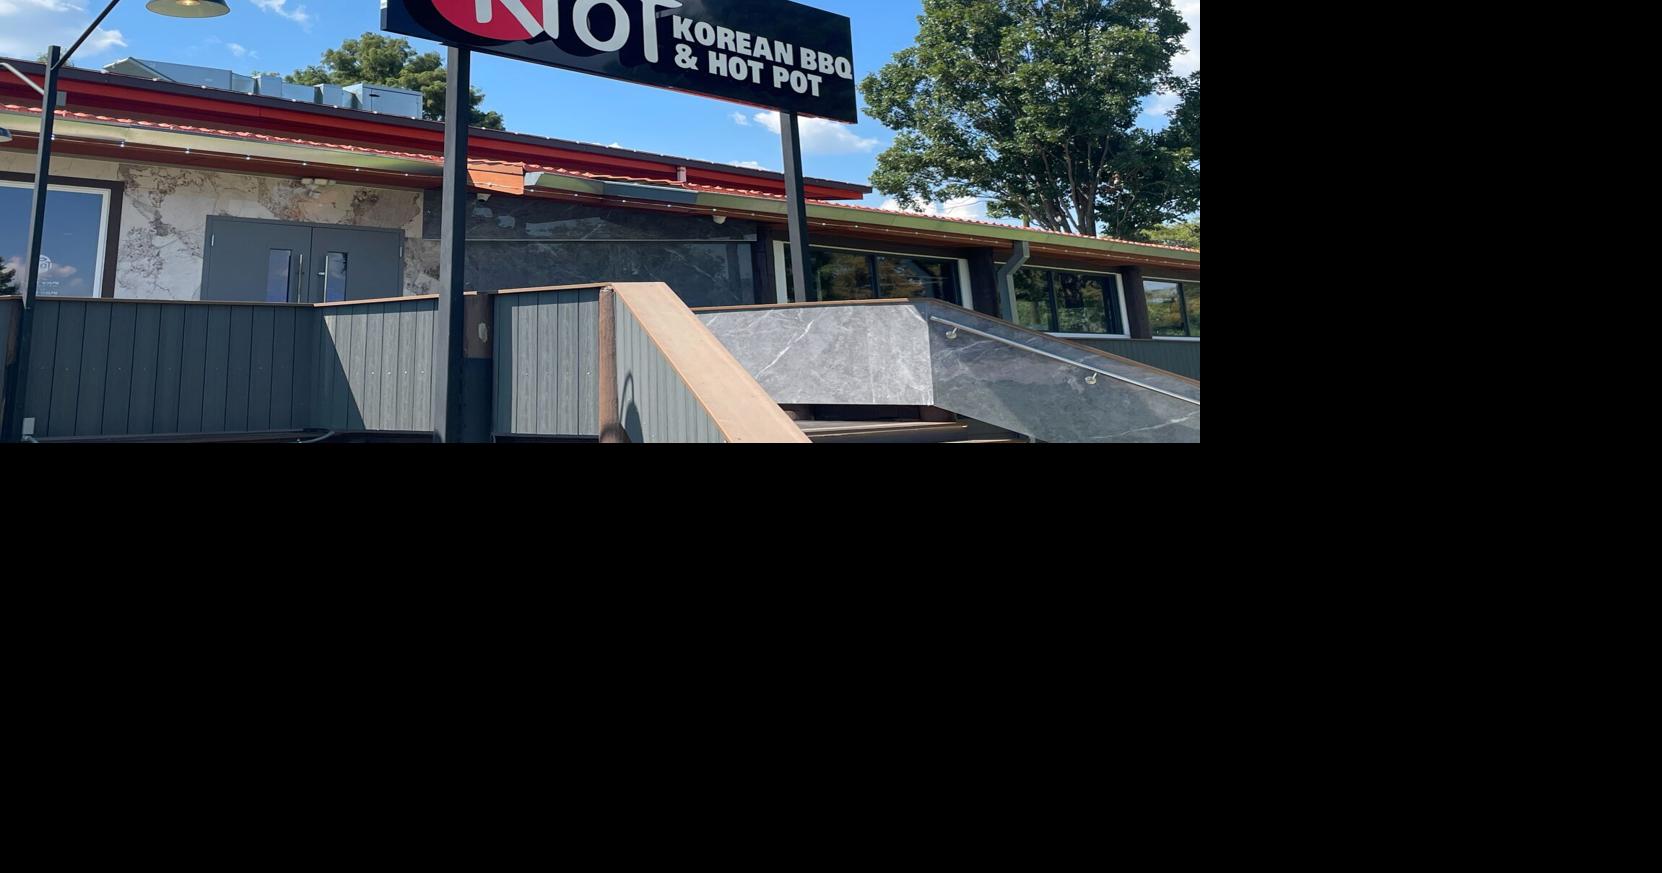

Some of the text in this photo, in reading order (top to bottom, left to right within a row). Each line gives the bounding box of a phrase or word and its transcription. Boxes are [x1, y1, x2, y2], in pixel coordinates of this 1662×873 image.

[672, 14, 853, 80] KOREAN BBQ
[674, 43, 823, 97] & HOT POT
